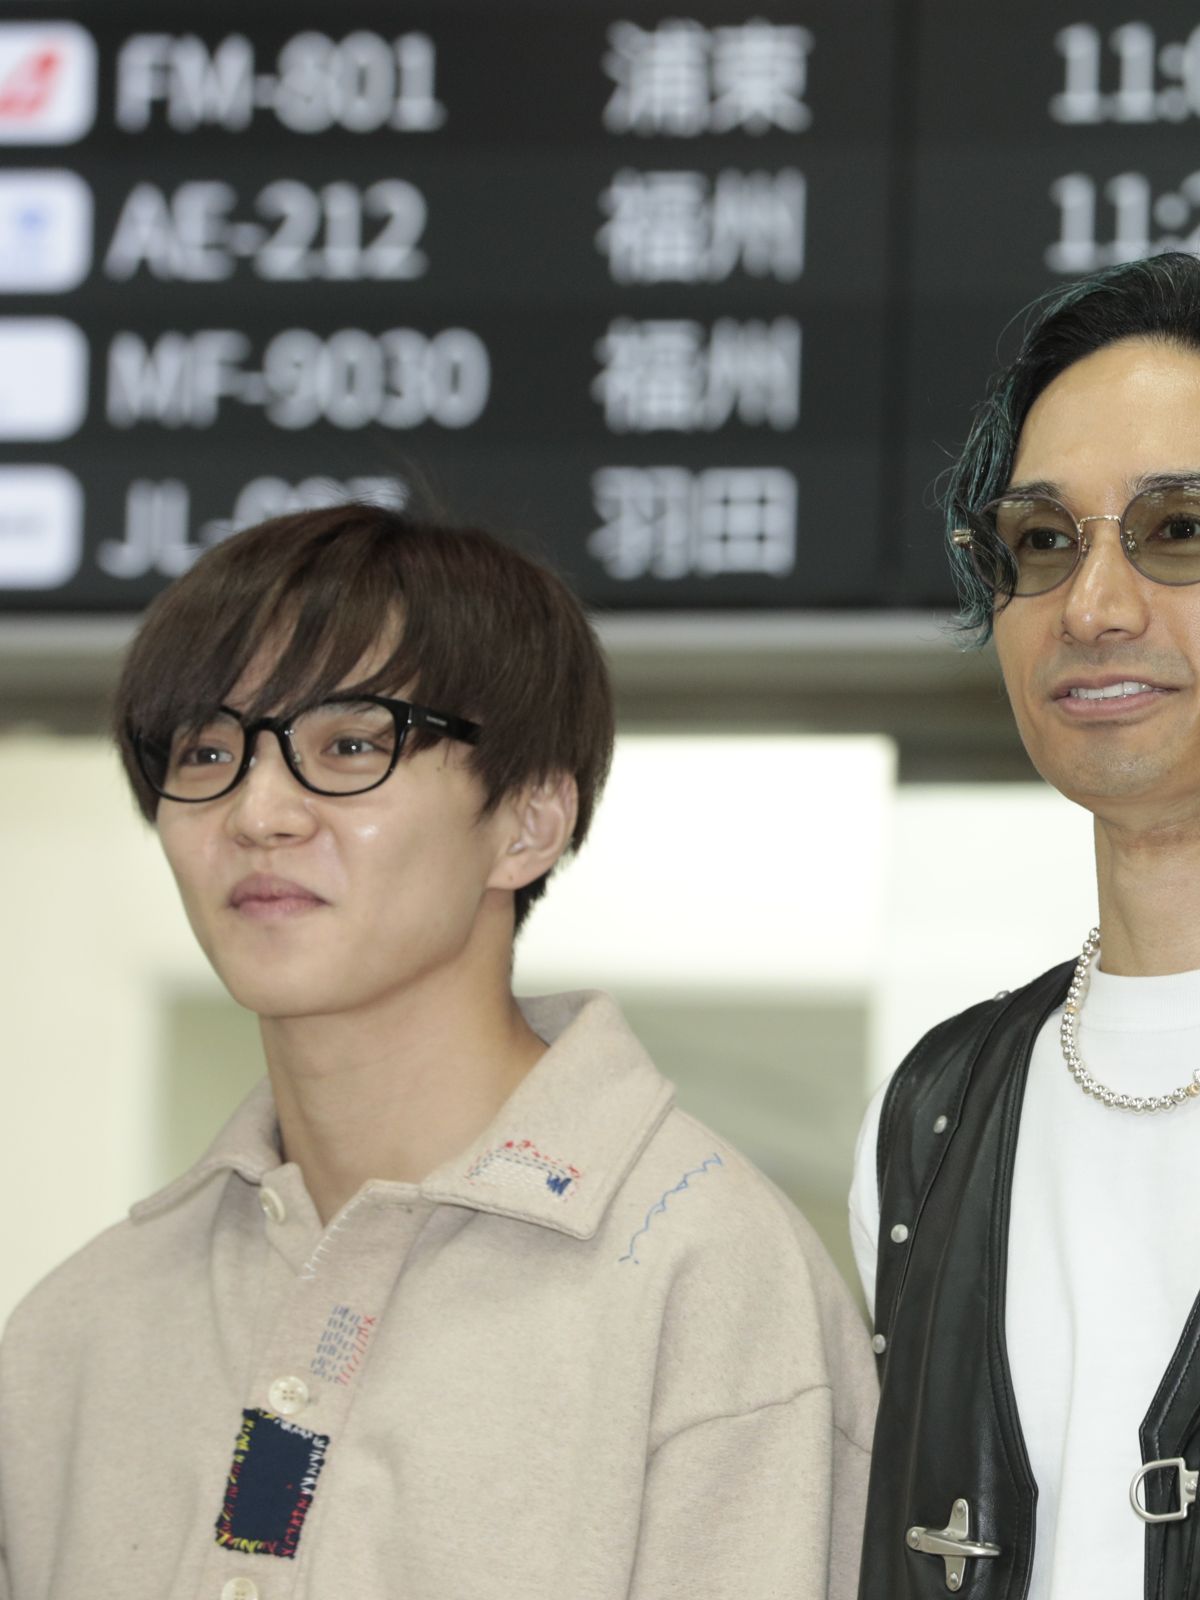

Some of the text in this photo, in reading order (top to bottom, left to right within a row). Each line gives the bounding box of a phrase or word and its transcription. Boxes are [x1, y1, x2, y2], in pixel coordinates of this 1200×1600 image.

[117, 31, 441, 132] FM-801
[606, 20, 810, 136] 浦東
[105, 179, 426, 281] AE-212
[598, 169, 806, 283] 福州
[106, 328, 490, 429] MF-9030
[594, 319, 801, 431] 福州
[590, 466, 798, 579] 羽田
